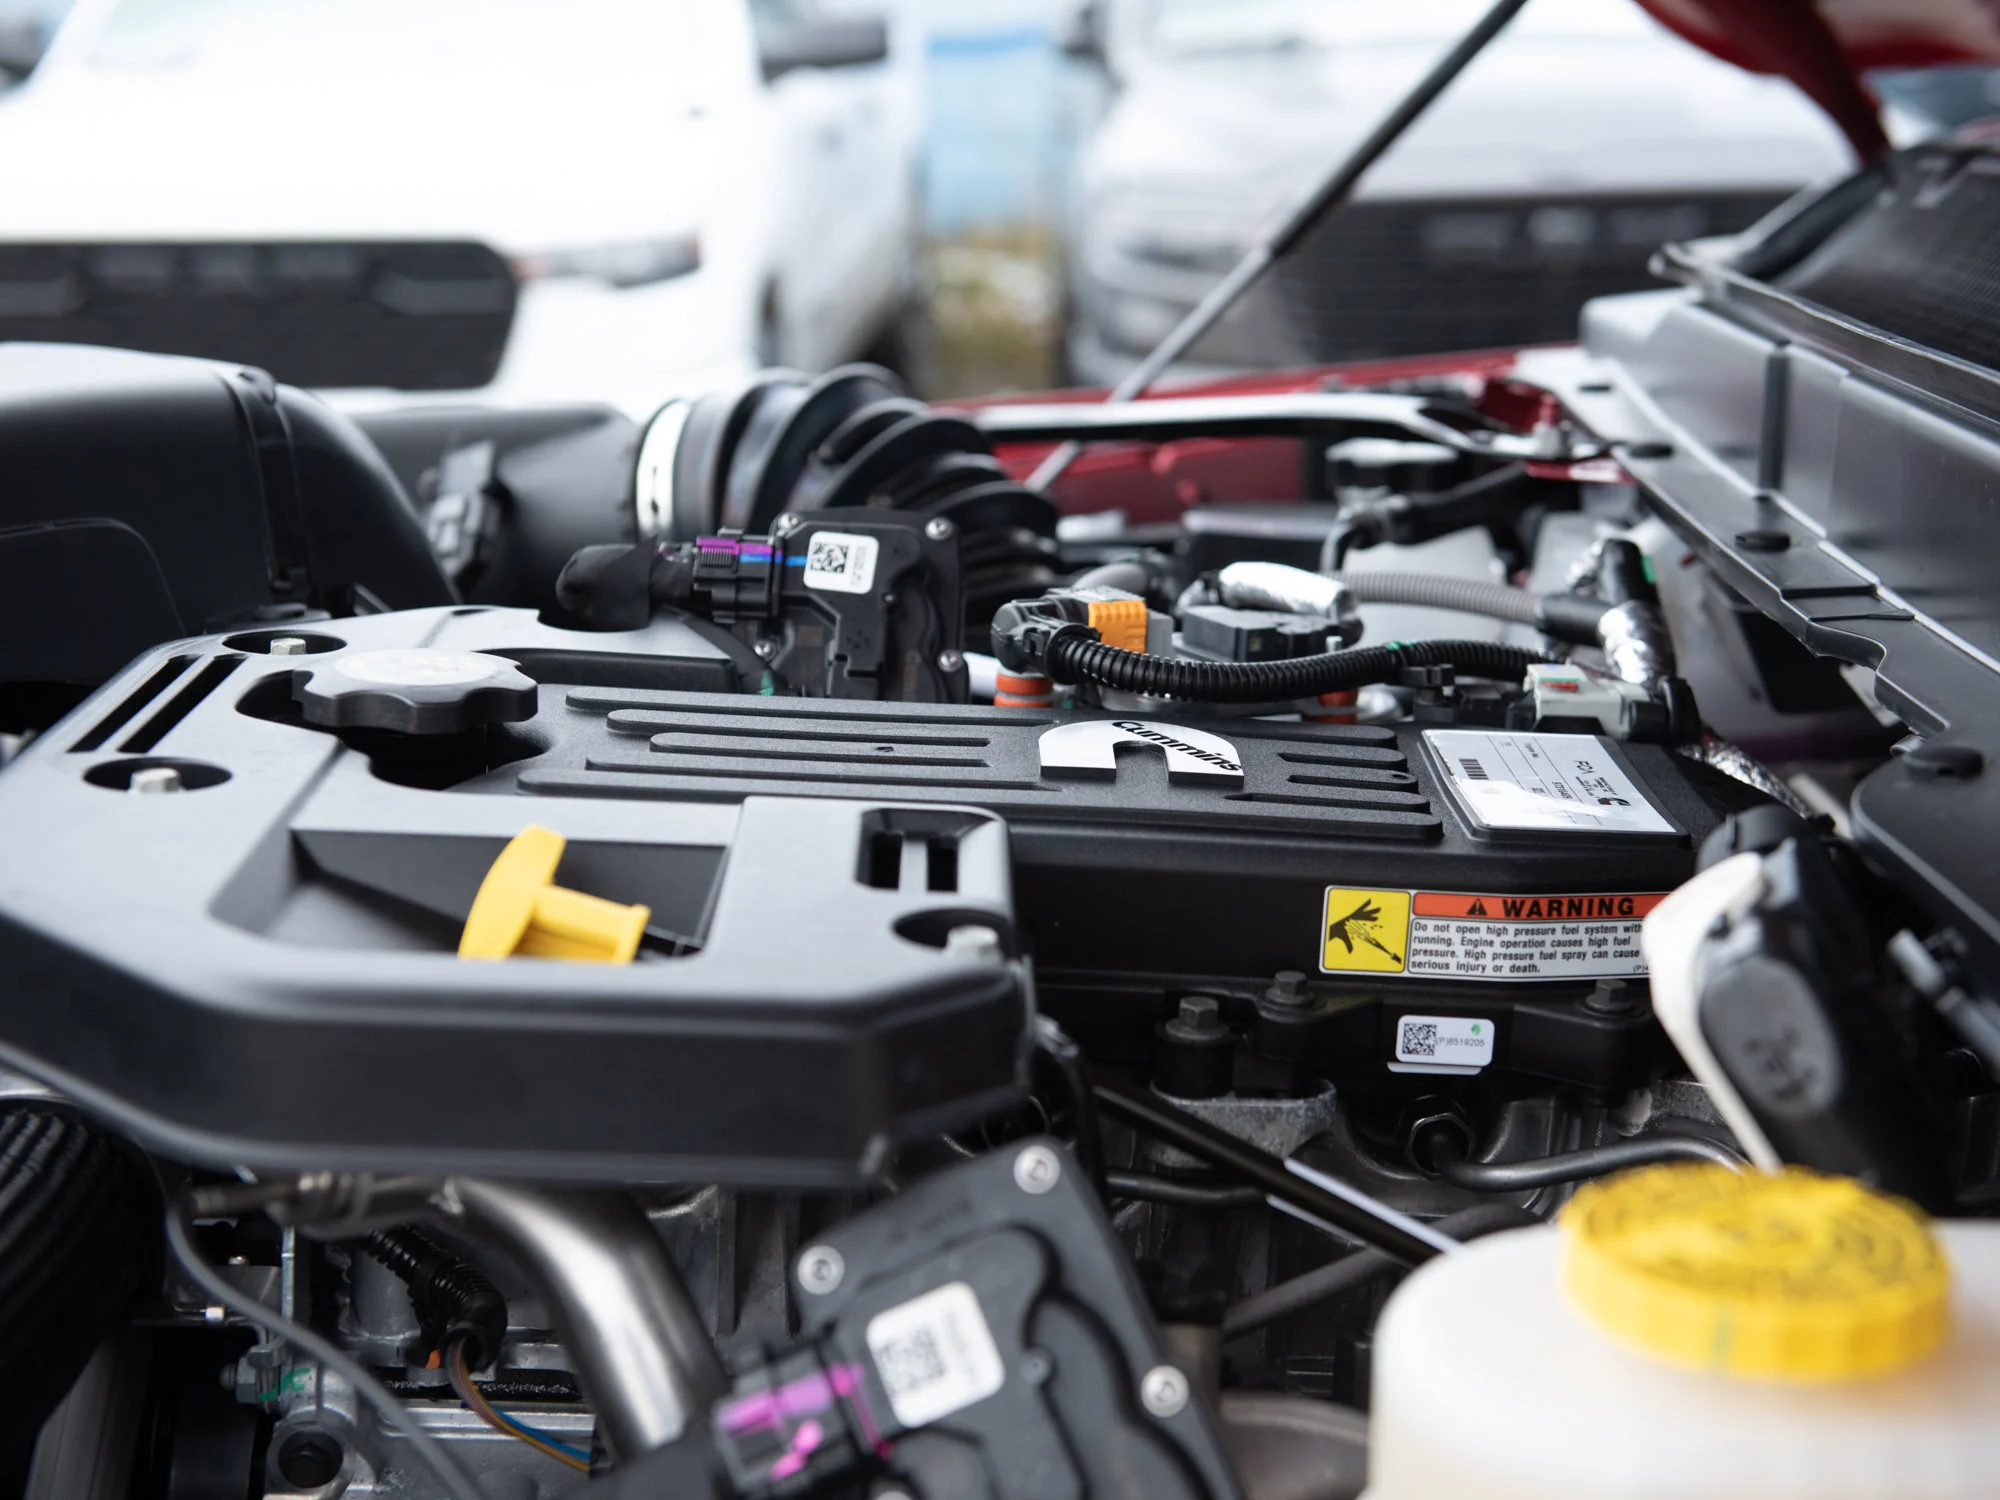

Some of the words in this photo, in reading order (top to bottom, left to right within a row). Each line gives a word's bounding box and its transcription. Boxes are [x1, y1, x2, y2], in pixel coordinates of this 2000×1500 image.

[1112, 720, 1242, 772] Cummins
[1501, 897, 1634, 918] WARNING
[1414, 921, 1427, 932] Do
[1433, 923, 1450, 933] not
[1455, 925, 1480, 937] open
[1486, 925, 1508, 937] high
[1514, 926, 1556, 938] pressure
[1561, 925, 1580, 935] fuel
[1584, 925, 1618, 936] system
[1413, 935, 1455, 947] running.
[1461, 937, 1494, 948] Engine
[1500, 938, 1546, 949] operation
[1551, 939, 1583, 948] causes
[1588, 937, 1608, 948] high
[1613, 936, 1631, 946] fuel
[1412, 948, 1459, 958] pressure.
[1464, 949, 1486, 960] High
[1492, 951, 1534, 961] pressure
[1539, 950, 1557, 960] fuel
[1561, 951, 1587, 961] spray
[1592, 950, 1608, 959] can
[1613, 949, 1640, 959] cause
[1411, 960, 1450, 970] serious
[1456, 961, 1487, 973] injury
[1492, 964, 1504, 973] or
[1509, 963, 1540, 974] death.
